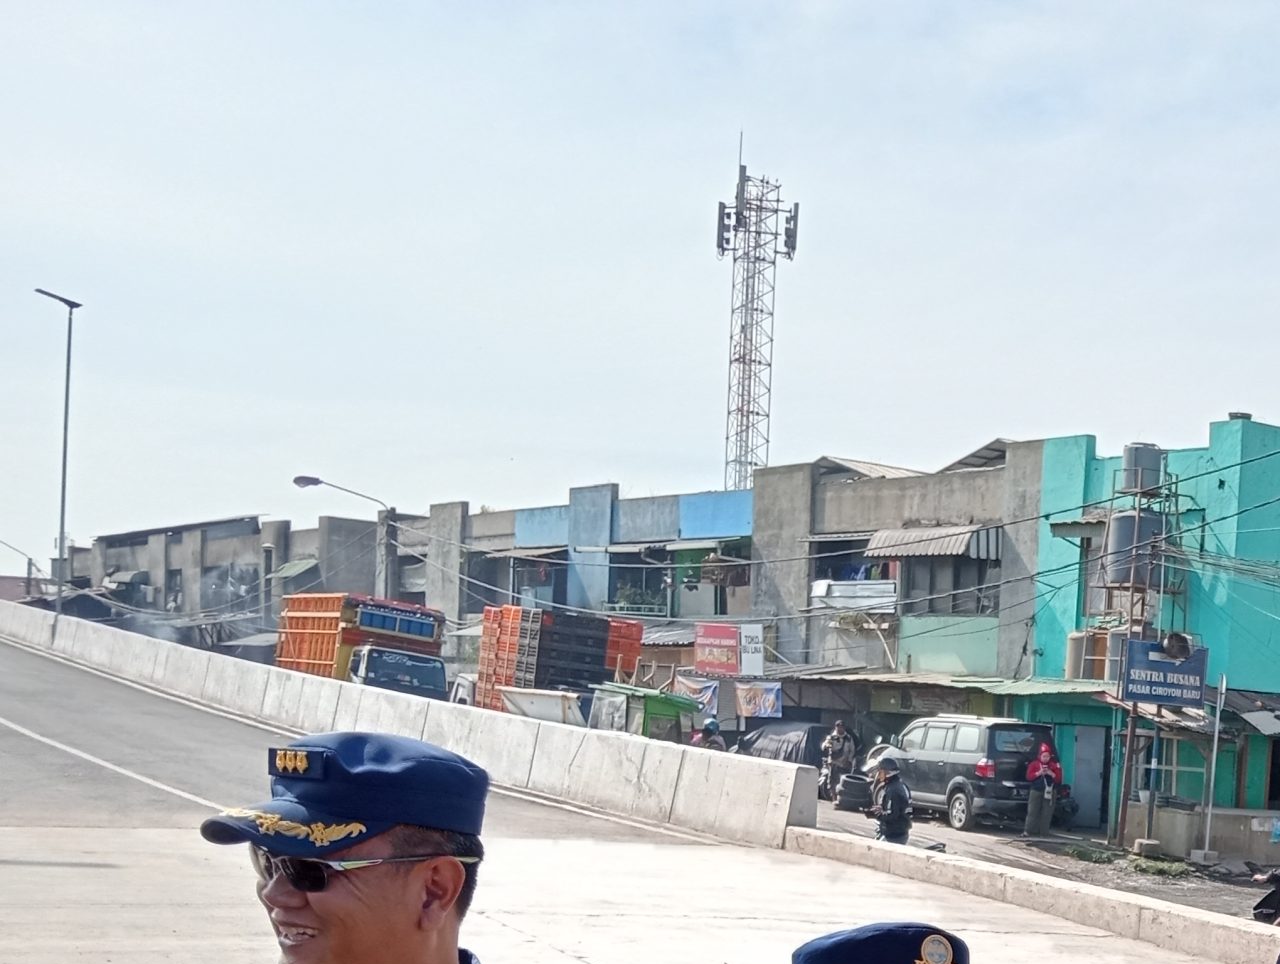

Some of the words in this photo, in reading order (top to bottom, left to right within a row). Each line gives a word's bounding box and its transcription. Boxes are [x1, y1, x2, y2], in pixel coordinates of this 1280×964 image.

[744, 635, 759, 645] TOKO
[743, 646, 750, 654] BU
[1130, 669, 1164, 683] SENTRA
[1166, 672, 1200, 687] BUSANA
[1128, 684, 1150, 693] PASAR
[1151, 686, 1181, 698] CIROYOM
[1182, 689, 1201, 699] BARU
